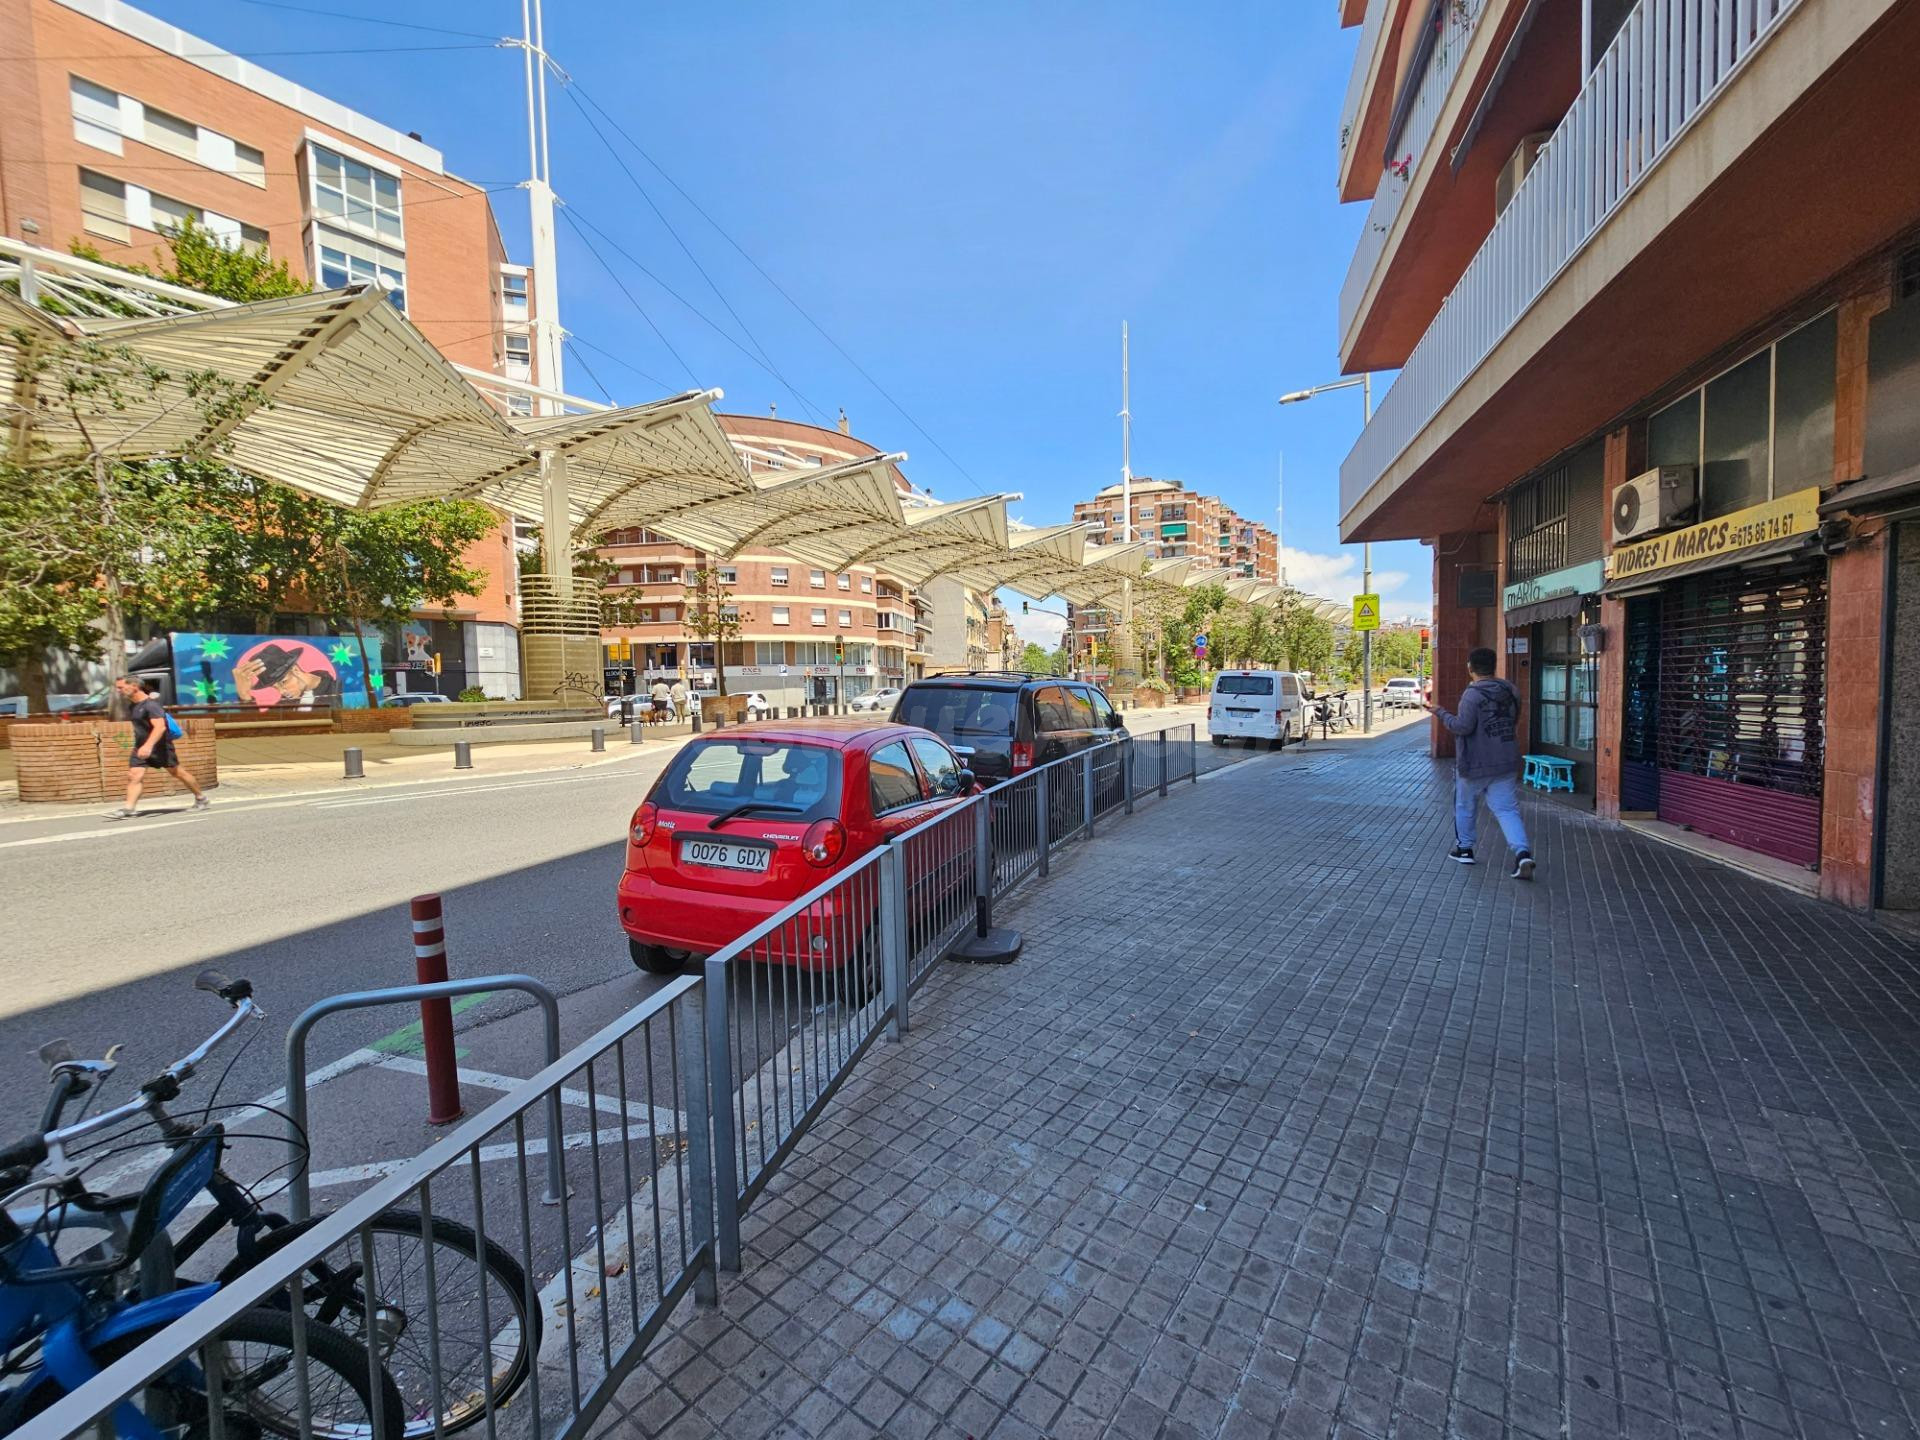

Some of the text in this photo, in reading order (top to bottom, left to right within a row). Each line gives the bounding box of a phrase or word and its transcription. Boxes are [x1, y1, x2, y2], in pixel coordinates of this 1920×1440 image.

[1616, 513, 1794, 574] VIDRES I MARCS 675 86 74 67
[762, 833, 800, 841] CHEVROLET
[691, 843, 767, 867] 0076 GDX
